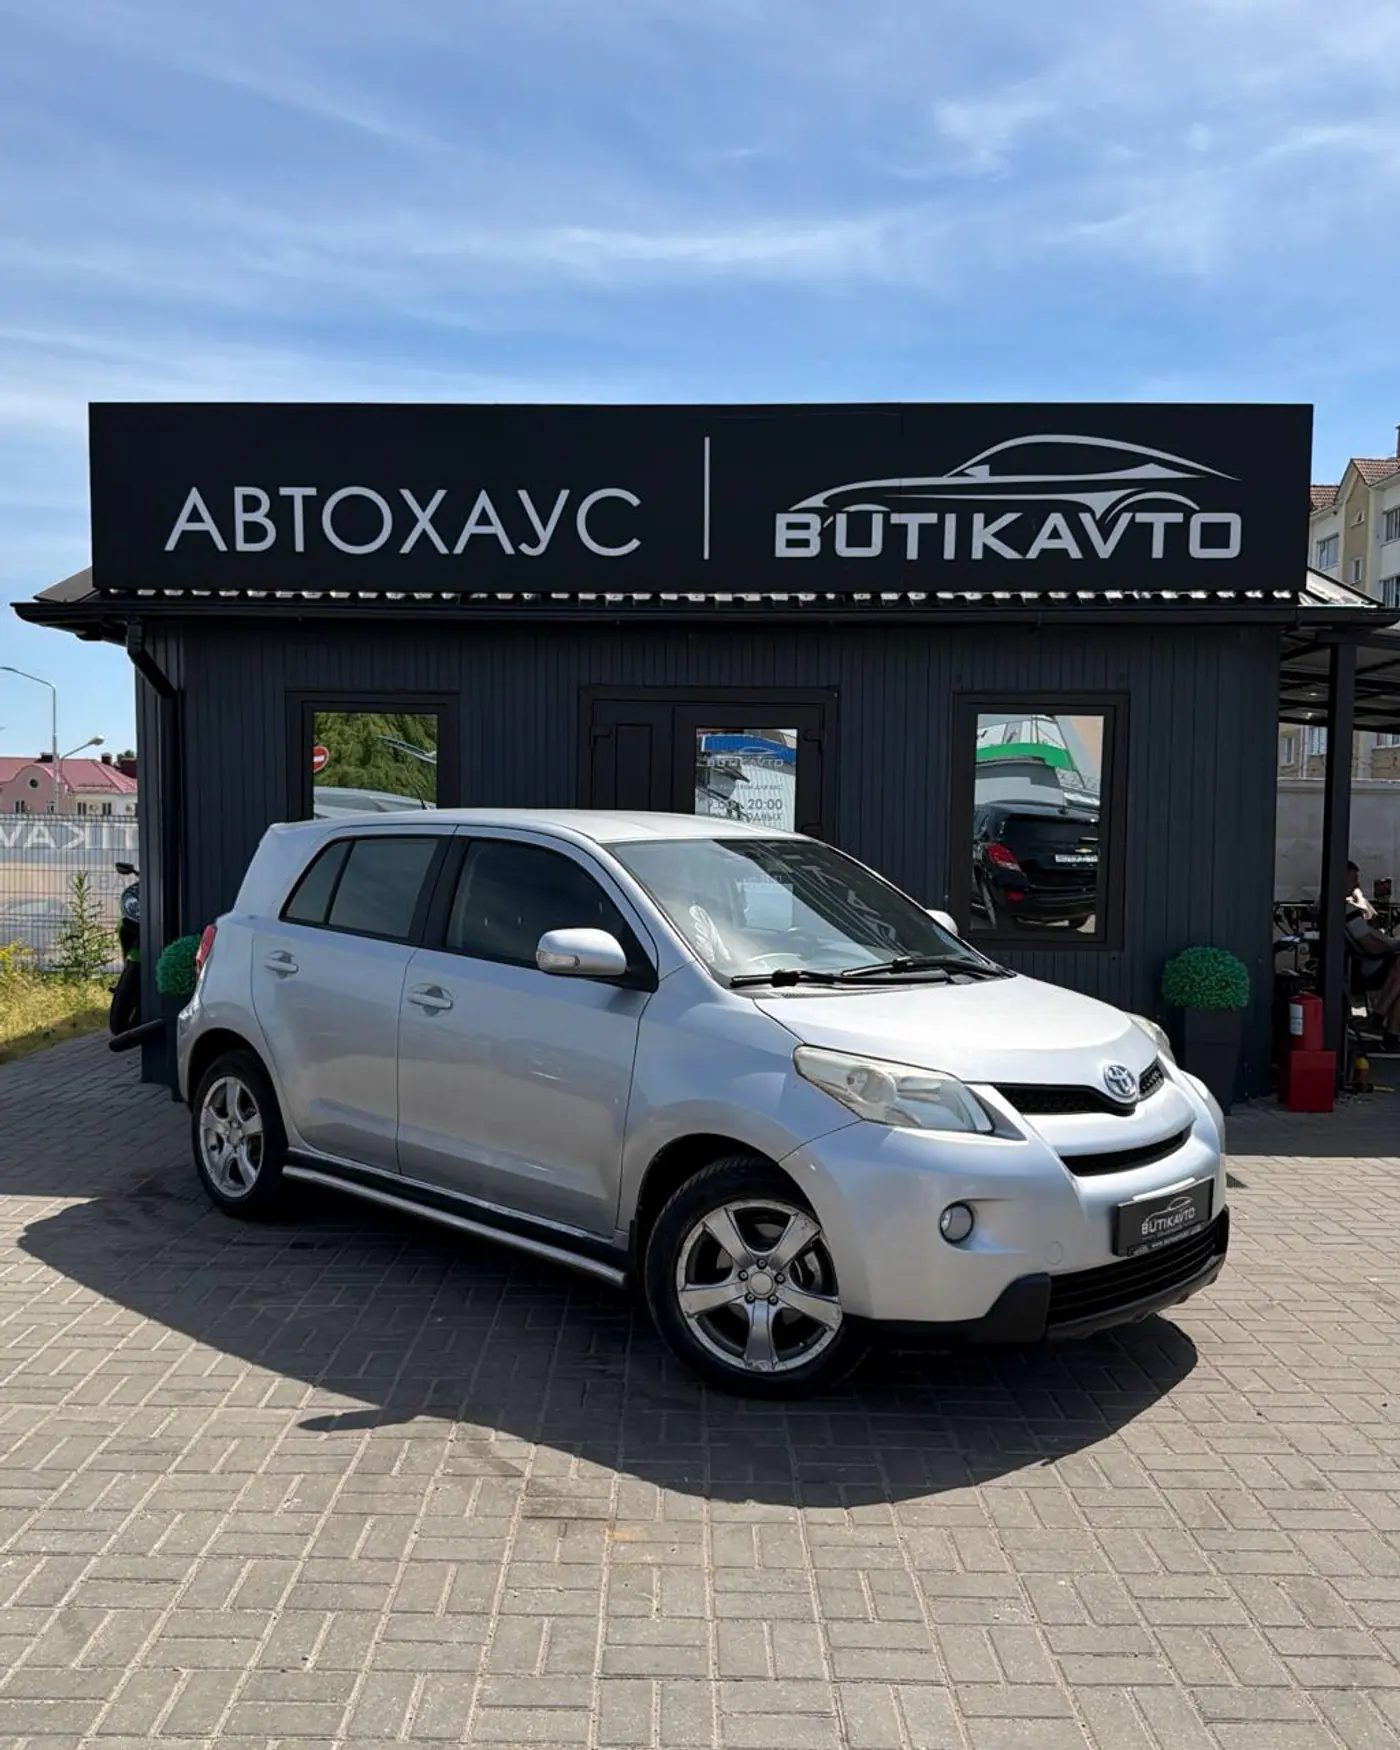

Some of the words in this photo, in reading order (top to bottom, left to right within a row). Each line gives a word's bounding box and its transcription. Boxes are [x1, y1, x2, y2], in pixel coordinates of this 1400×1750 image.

[163, 486, 642, 557] АВТОХАУС
[774, 511, 1243, 561] BUTIKAVTO
[747, 798, 783, 811] 20:00
[1141, 1207, 1196, 1235] BUTIKAVTO
